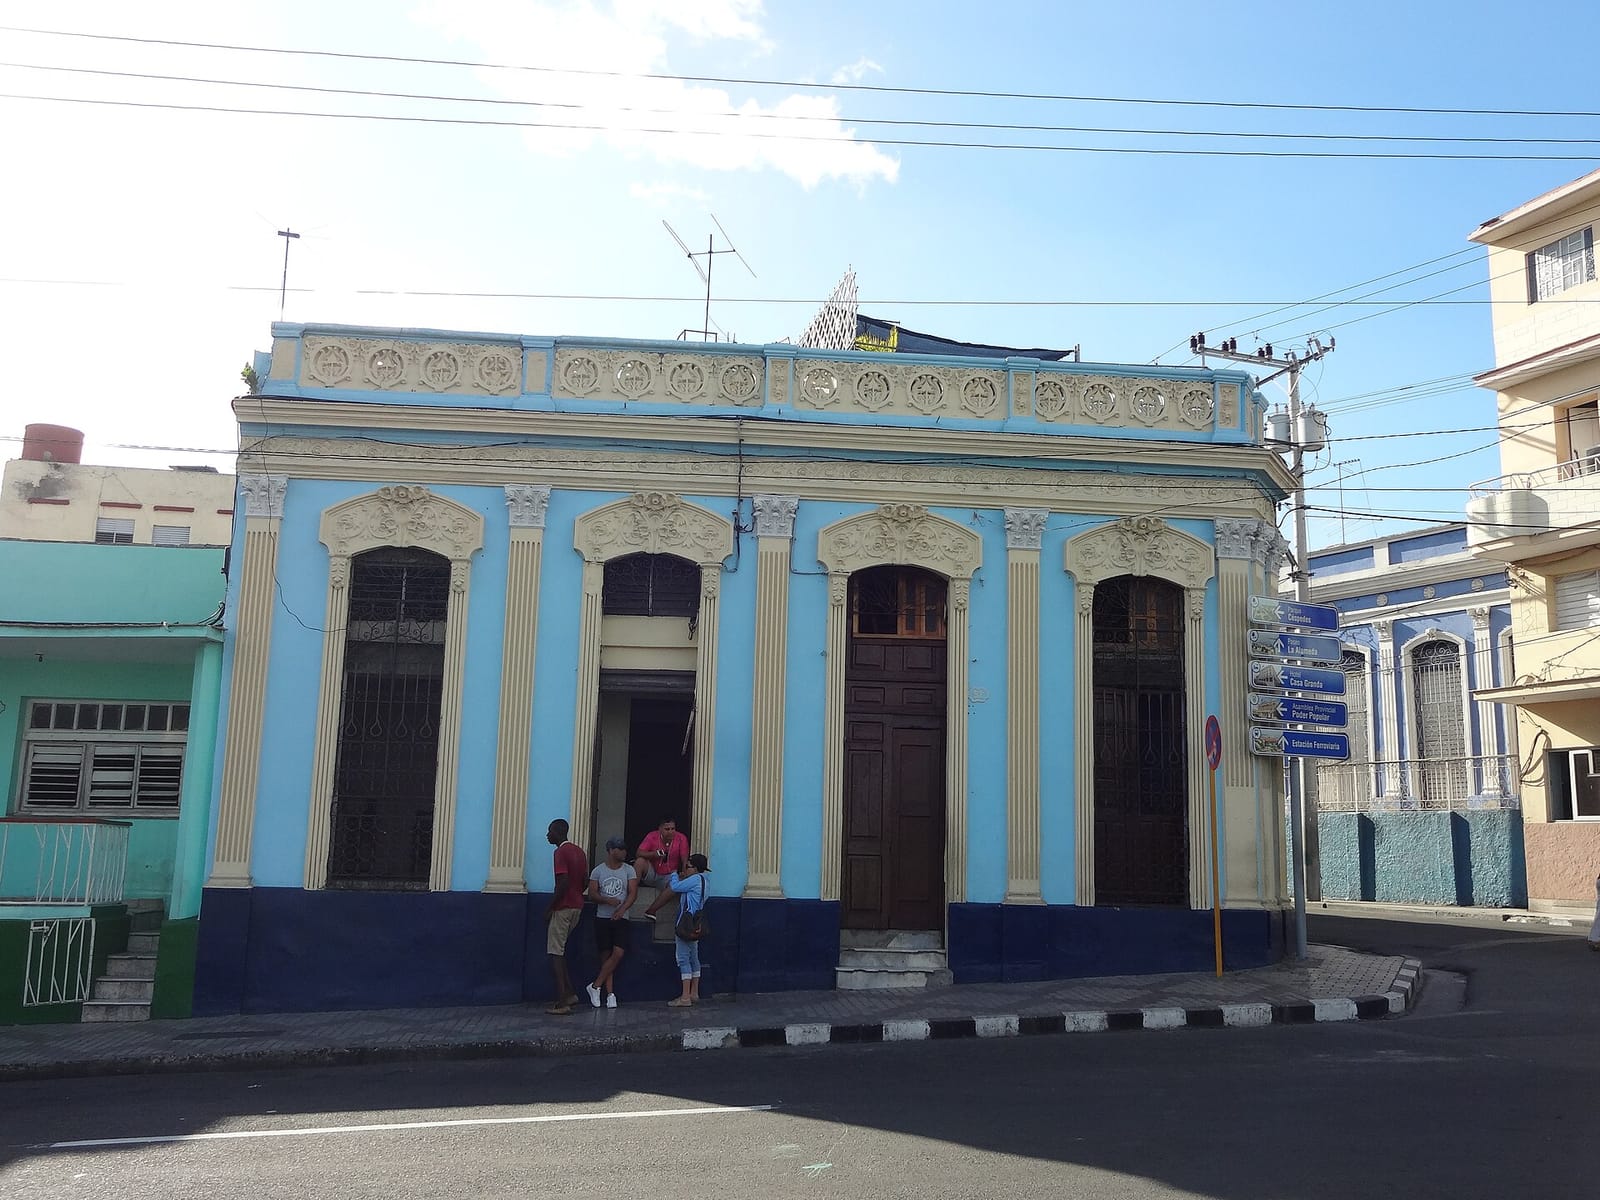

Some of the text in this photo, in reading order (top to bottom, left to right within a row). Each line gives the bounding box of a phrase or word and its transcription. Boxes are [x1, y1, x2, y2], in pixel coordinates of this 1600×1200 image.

[1288, 614, 1311, 623] Céspedes
[1288, 645, 1318, 656] La Alameda
[1290, 678, 1303, 687] Casa
[1292, 710, 1330, 721] Poder Popular
[1292, 739, 1340, 750] Estación Ferroviaria
